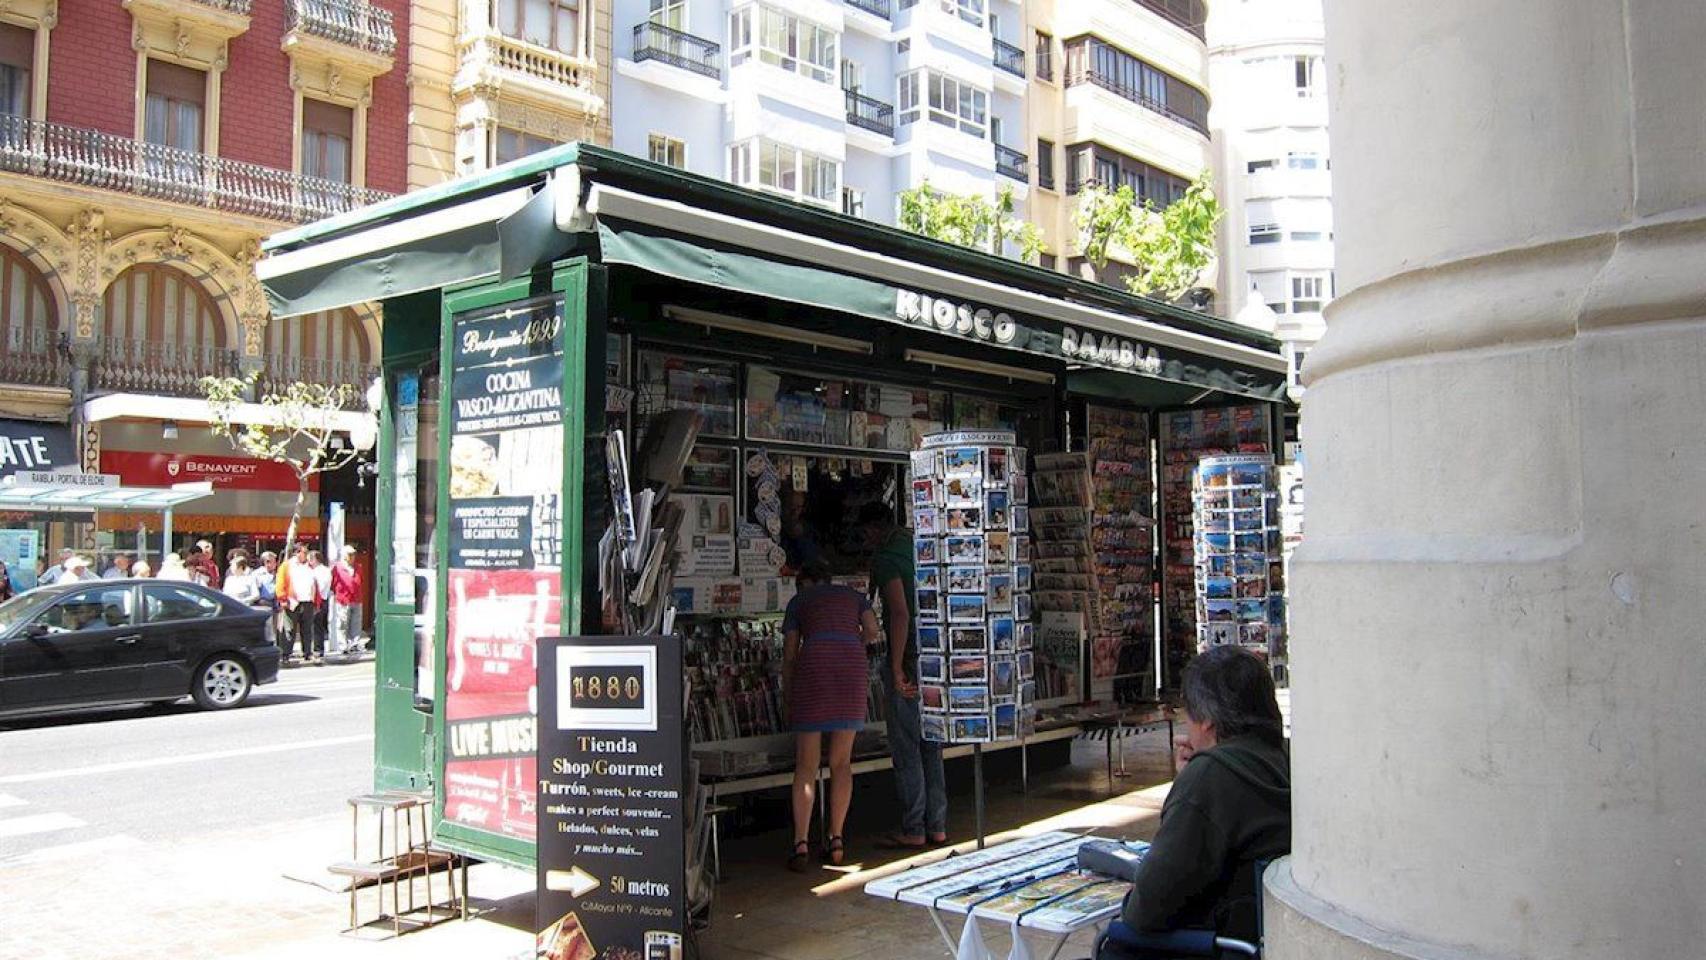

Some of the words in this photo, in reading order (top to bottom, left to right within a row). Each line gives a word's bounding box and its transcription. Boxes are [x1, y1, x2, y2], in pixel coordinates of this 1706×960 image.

[896, 288, 1016, 343] KIOSCO
[1062, 326, 1162, 375] RAMBLA
[486, 370, 531, 393] COCINA
[457, 387, 561, 418] VASCO-ALICANTINA
[572, 675, 641, 699] 1880
[451, 722, 489, 757] LIVE
[577, 736, 638, 753] Tienda
[552, 757, 664, 778] Shop/Gourmet
[547, 804, 576, 815] makes
[578, 807, 584, 815] a
[586, 805, 620, 817] perfect
[558, 821, 598, 836] Helados,
[600, 824, 633, 837] dulces,
[635, 826, 660, 837] velas
[574, 844, 581, 854] y
[582, 843, 615, 854] mucho
[610, 875, 625, 894] 50
[628, 880, 670, 897] metros
[639, 905, 673, 918] Alicante
